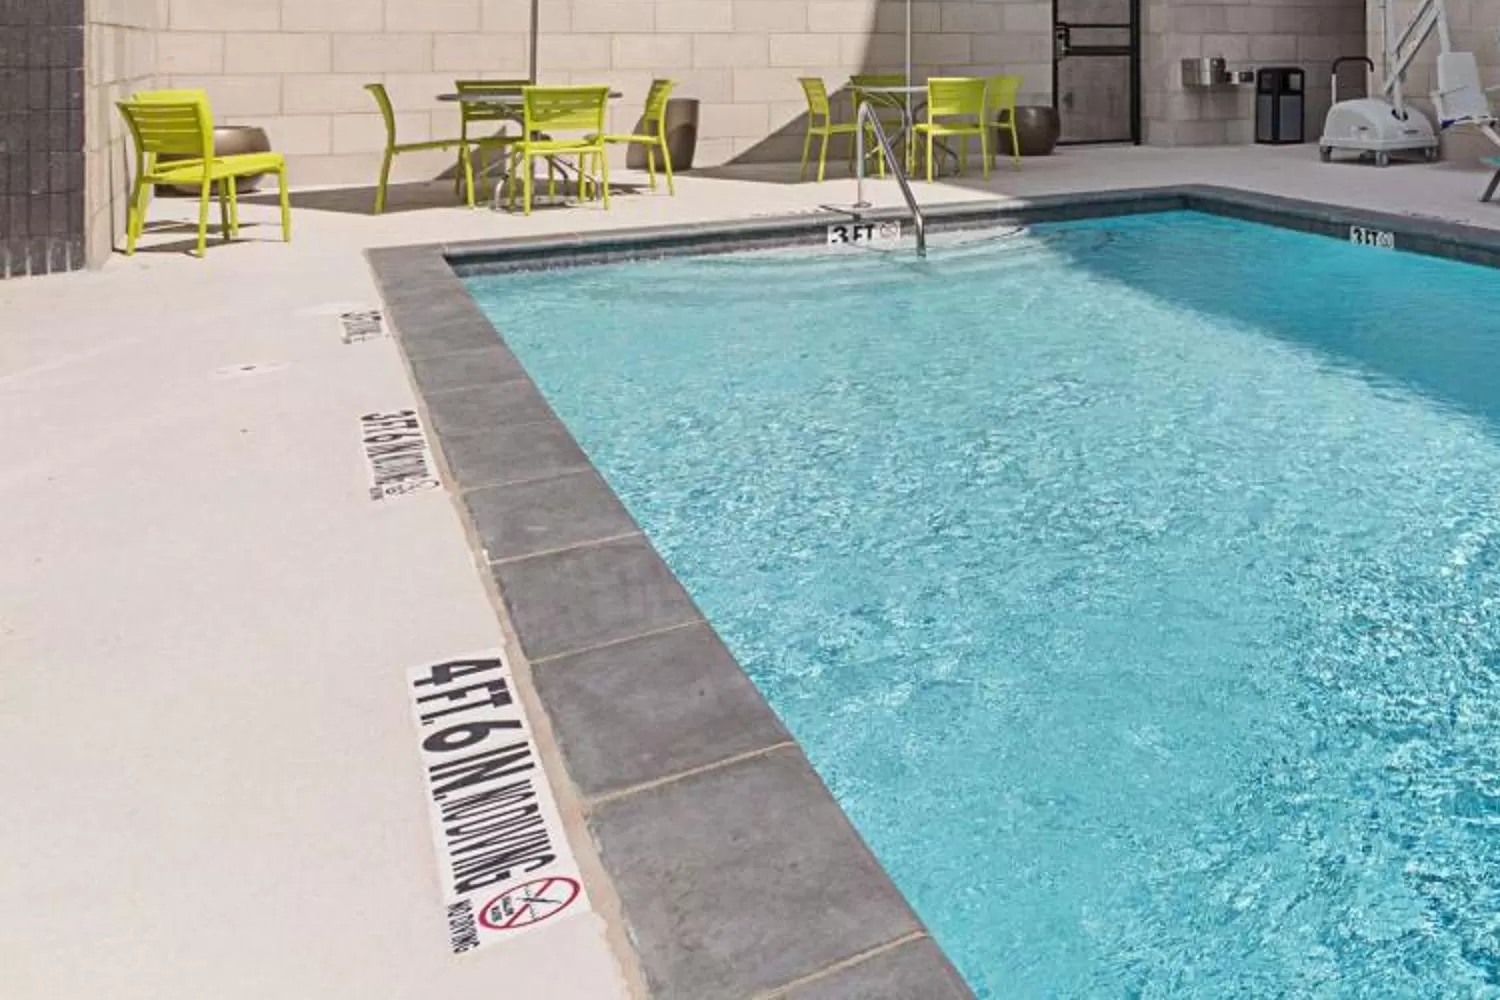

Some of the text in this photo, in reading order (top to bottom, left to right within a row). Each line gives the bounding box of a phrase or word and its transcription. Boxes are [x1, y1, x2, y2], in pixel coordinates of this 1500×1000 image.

[831, 223, 875, 243] 3 FT
[413, 658, 503, 687] 4
[422, 719, 523, 753] 6
[440, 778, 536, 822] NO
[445, 802, 557, 894] DIVING
[450, 913, 481, 954] DIVING
